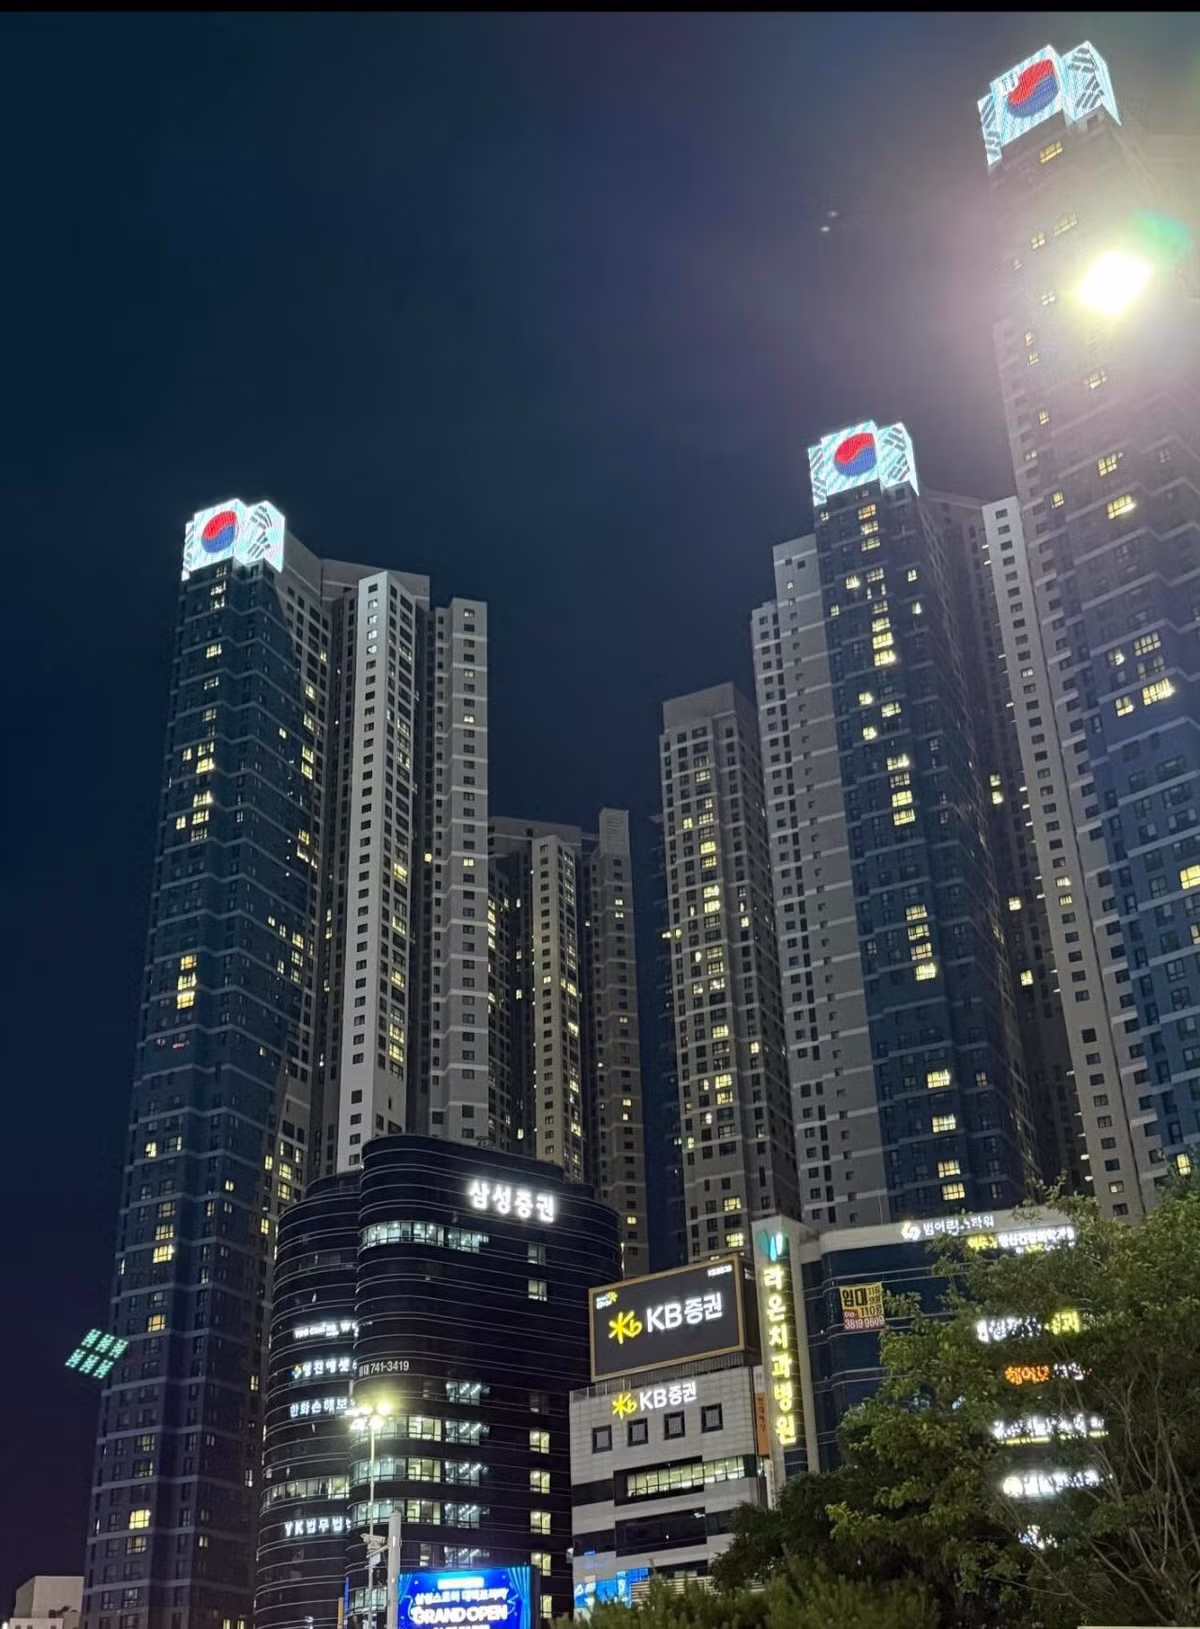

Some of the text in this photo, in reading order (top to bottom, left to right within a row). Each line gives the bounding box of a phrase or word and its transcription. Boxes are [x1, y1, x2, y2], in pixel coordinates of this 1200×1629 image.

[468, 1178, 555, 1223] 삼성증권
[842, 1287, 868, 1307] 임대
[646, 1292, 722, 1333] KB증권
[370, 1360, 410, 1374] 741-3419
[763, 1264, 797, 1445] 라온치과병원
[639, 1381, 697, 1411] KB증권
[411, 1604, 508, 1624] GRAND OPEN
